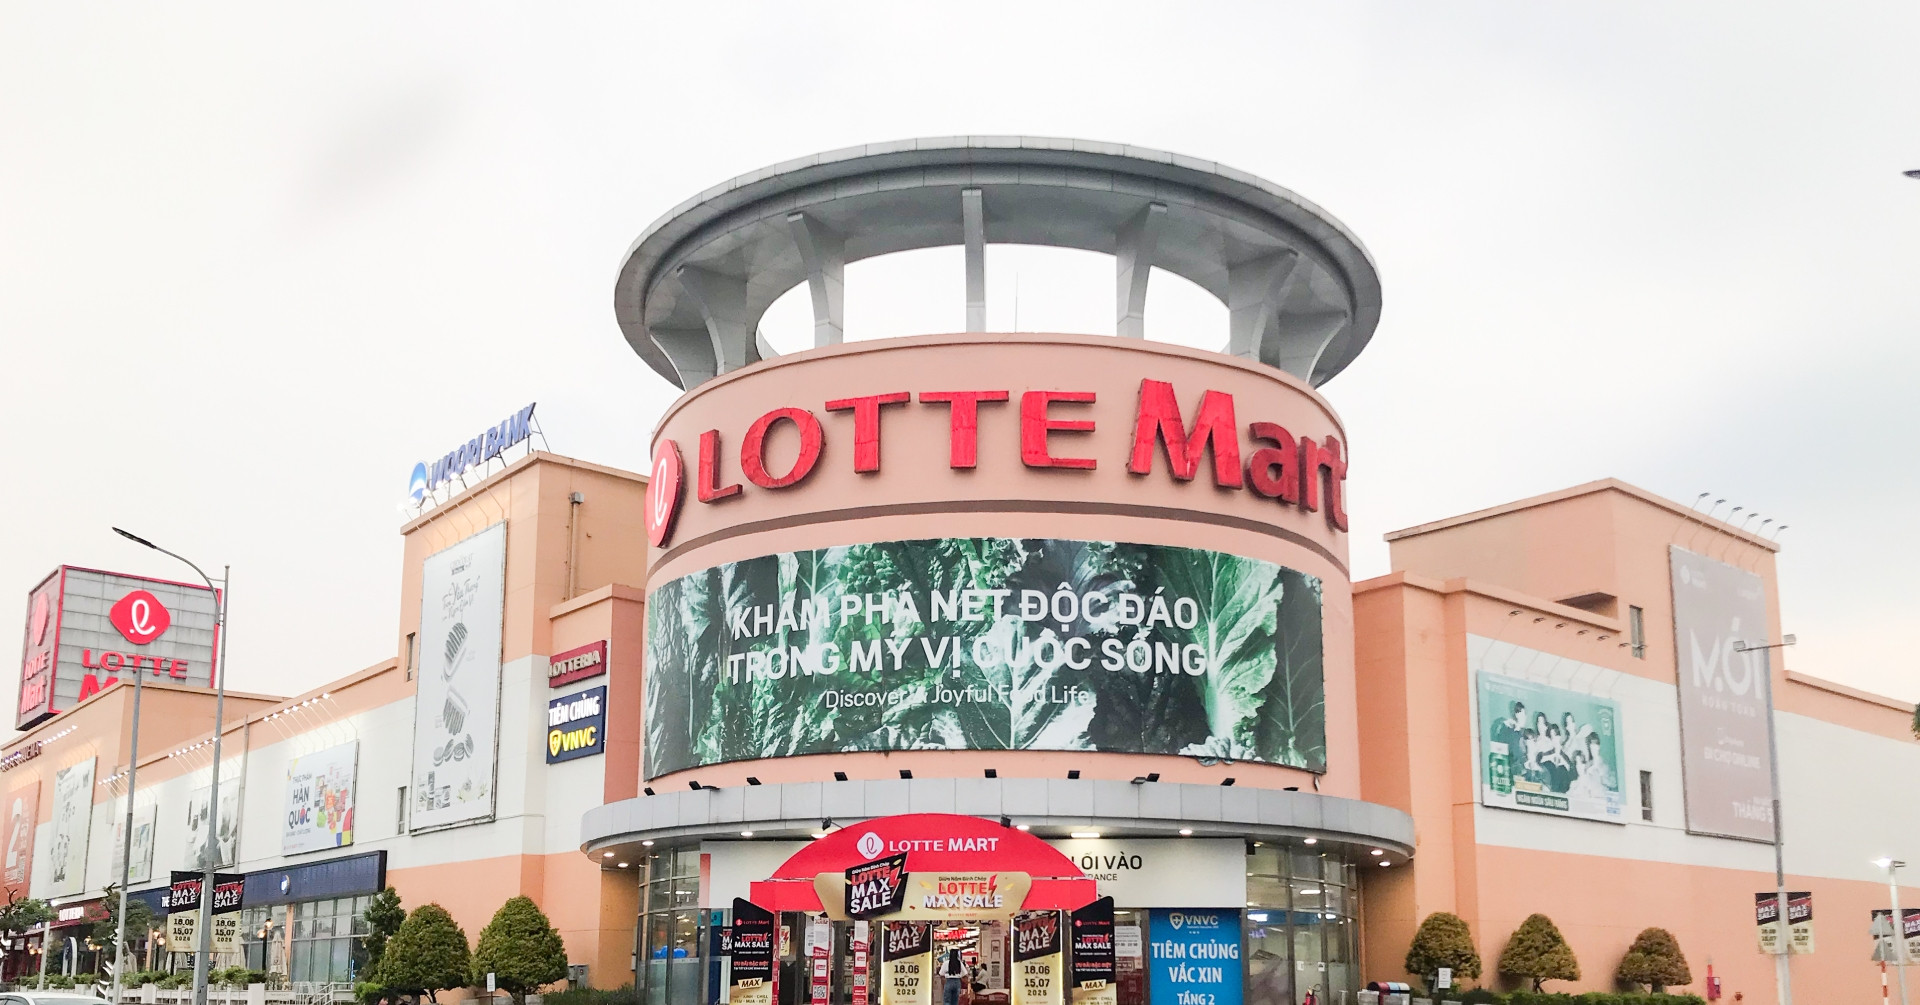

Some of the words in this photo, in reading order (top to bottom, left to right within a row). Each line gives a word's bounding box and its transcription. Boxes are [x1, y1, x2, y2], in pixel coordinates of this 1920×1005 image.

[431, 434, 483, 489] WOORI
[485, 402, 536, 461] BANK
[698, 390, 1097, 503] LOTTE
[1128, 378, 1348, 532] Mart
[841, 582, 922, 628] PHÁ
[931, 580, 1011, 622] NÉT
[1019, 582, 1109, 632] ĐỘC
[1119, 586, 1198, 630] ĐÁO
[82, 648, 188, 679] LOTTE
[548, 650, 601, 678] LOTTERIA
[728, 641, 839, 686] TRONG
[920, 636, 961, 677] VỊ
[1101, 630, 1207, 677] SỐNG
[826, 688, 908, 709] Discover
[931, 683, 992, 708] Joyful
[1051, 684, 1090, 704] Life
[562, 726, 597, 752] VNVC
[889, 839, 944, 852] LOTTE
[948, 837, 999, 852] MART
[1103, 851, 1143, 870] VÀO
[851, 866, 891, 886] LOTTE
[172, 887, 196, 899] MAX
[215, 890, 238, 901] MAX
[851, 877, 891, 900] MAX
[938, 882, 987, 894] LOTTE
[171, 895, 196, 907] SALE
[214, 897, 238, 908] SALE
[850, 891, 891, 914] SALE
[923, 894, 960, 908] MAX
[963, 894, 1004, 908] SALE
[1185, 914, 1219, 926] VNVC
[889, 926, 919, 943] MAX
[1019, 925, 1049, 943] MAX
[888, 936, 920, 953] SALE
[1018, 936, 1050, 953] SALE
[1075, 942, 1092, 950] MAX
[1093, 942, 1112, 950] SALE
[1152, 940, 1186, 959] TIÊM
[1189, 938, 1239, 960] CHỦNG
[894, 964, 920, 974] 18.06
[1024, 965, 1050, 975] 18.06
[1168, 962, 1195, 984] VẮC
[1197, 966, 1222, 983] XIN
[742, 979, 760, 988] MAX
[894, 978, 919, 988] 15.07
[1024, 979, 1050, 988] 15.07
[1084, 981, 1103, 990] MAX
[896, 988, 916, 996] 2025
[1027, 989, 1047, 997] 2025
[1208, 994, 1215, 1005] 2
